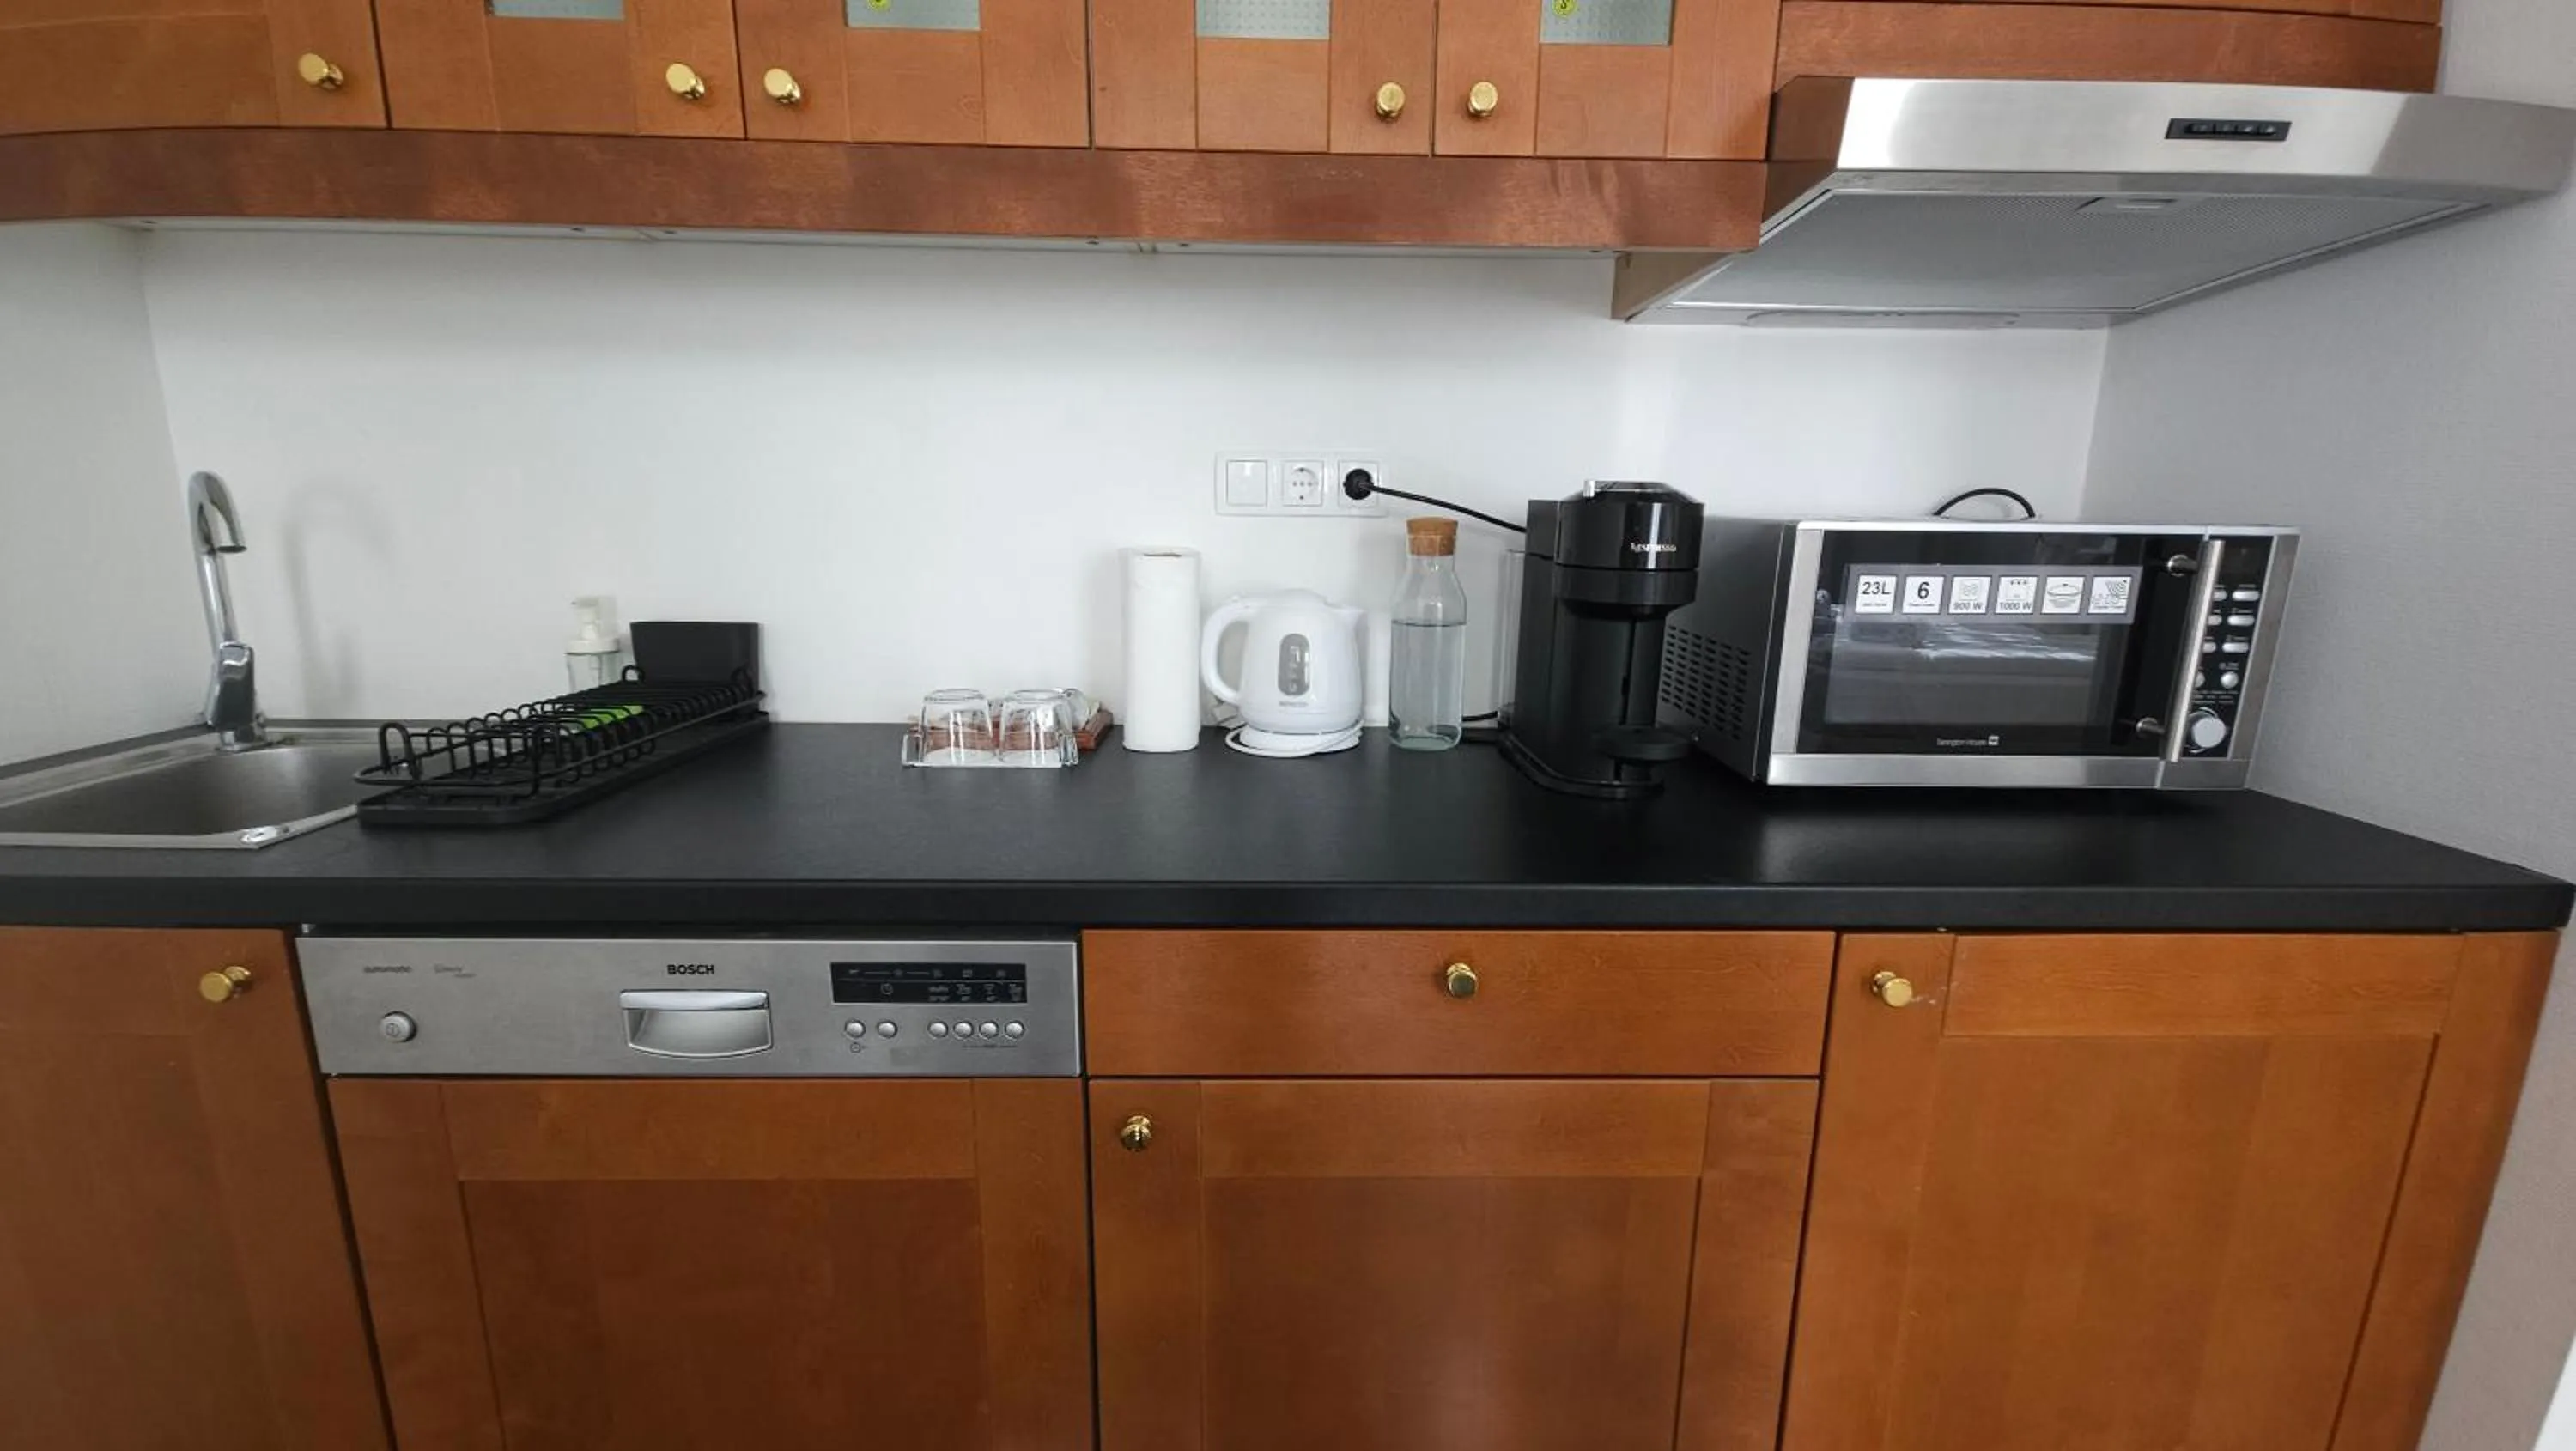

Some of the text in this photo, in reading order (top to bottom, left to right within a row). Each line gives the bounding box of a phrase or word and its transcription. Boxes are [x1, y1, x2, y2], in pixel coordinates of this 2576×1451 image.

[1861, 581, 1892, 595] 23L
[1917, 581, 1930, 599] 6
[667, 964, 715, 975] BOSCH
